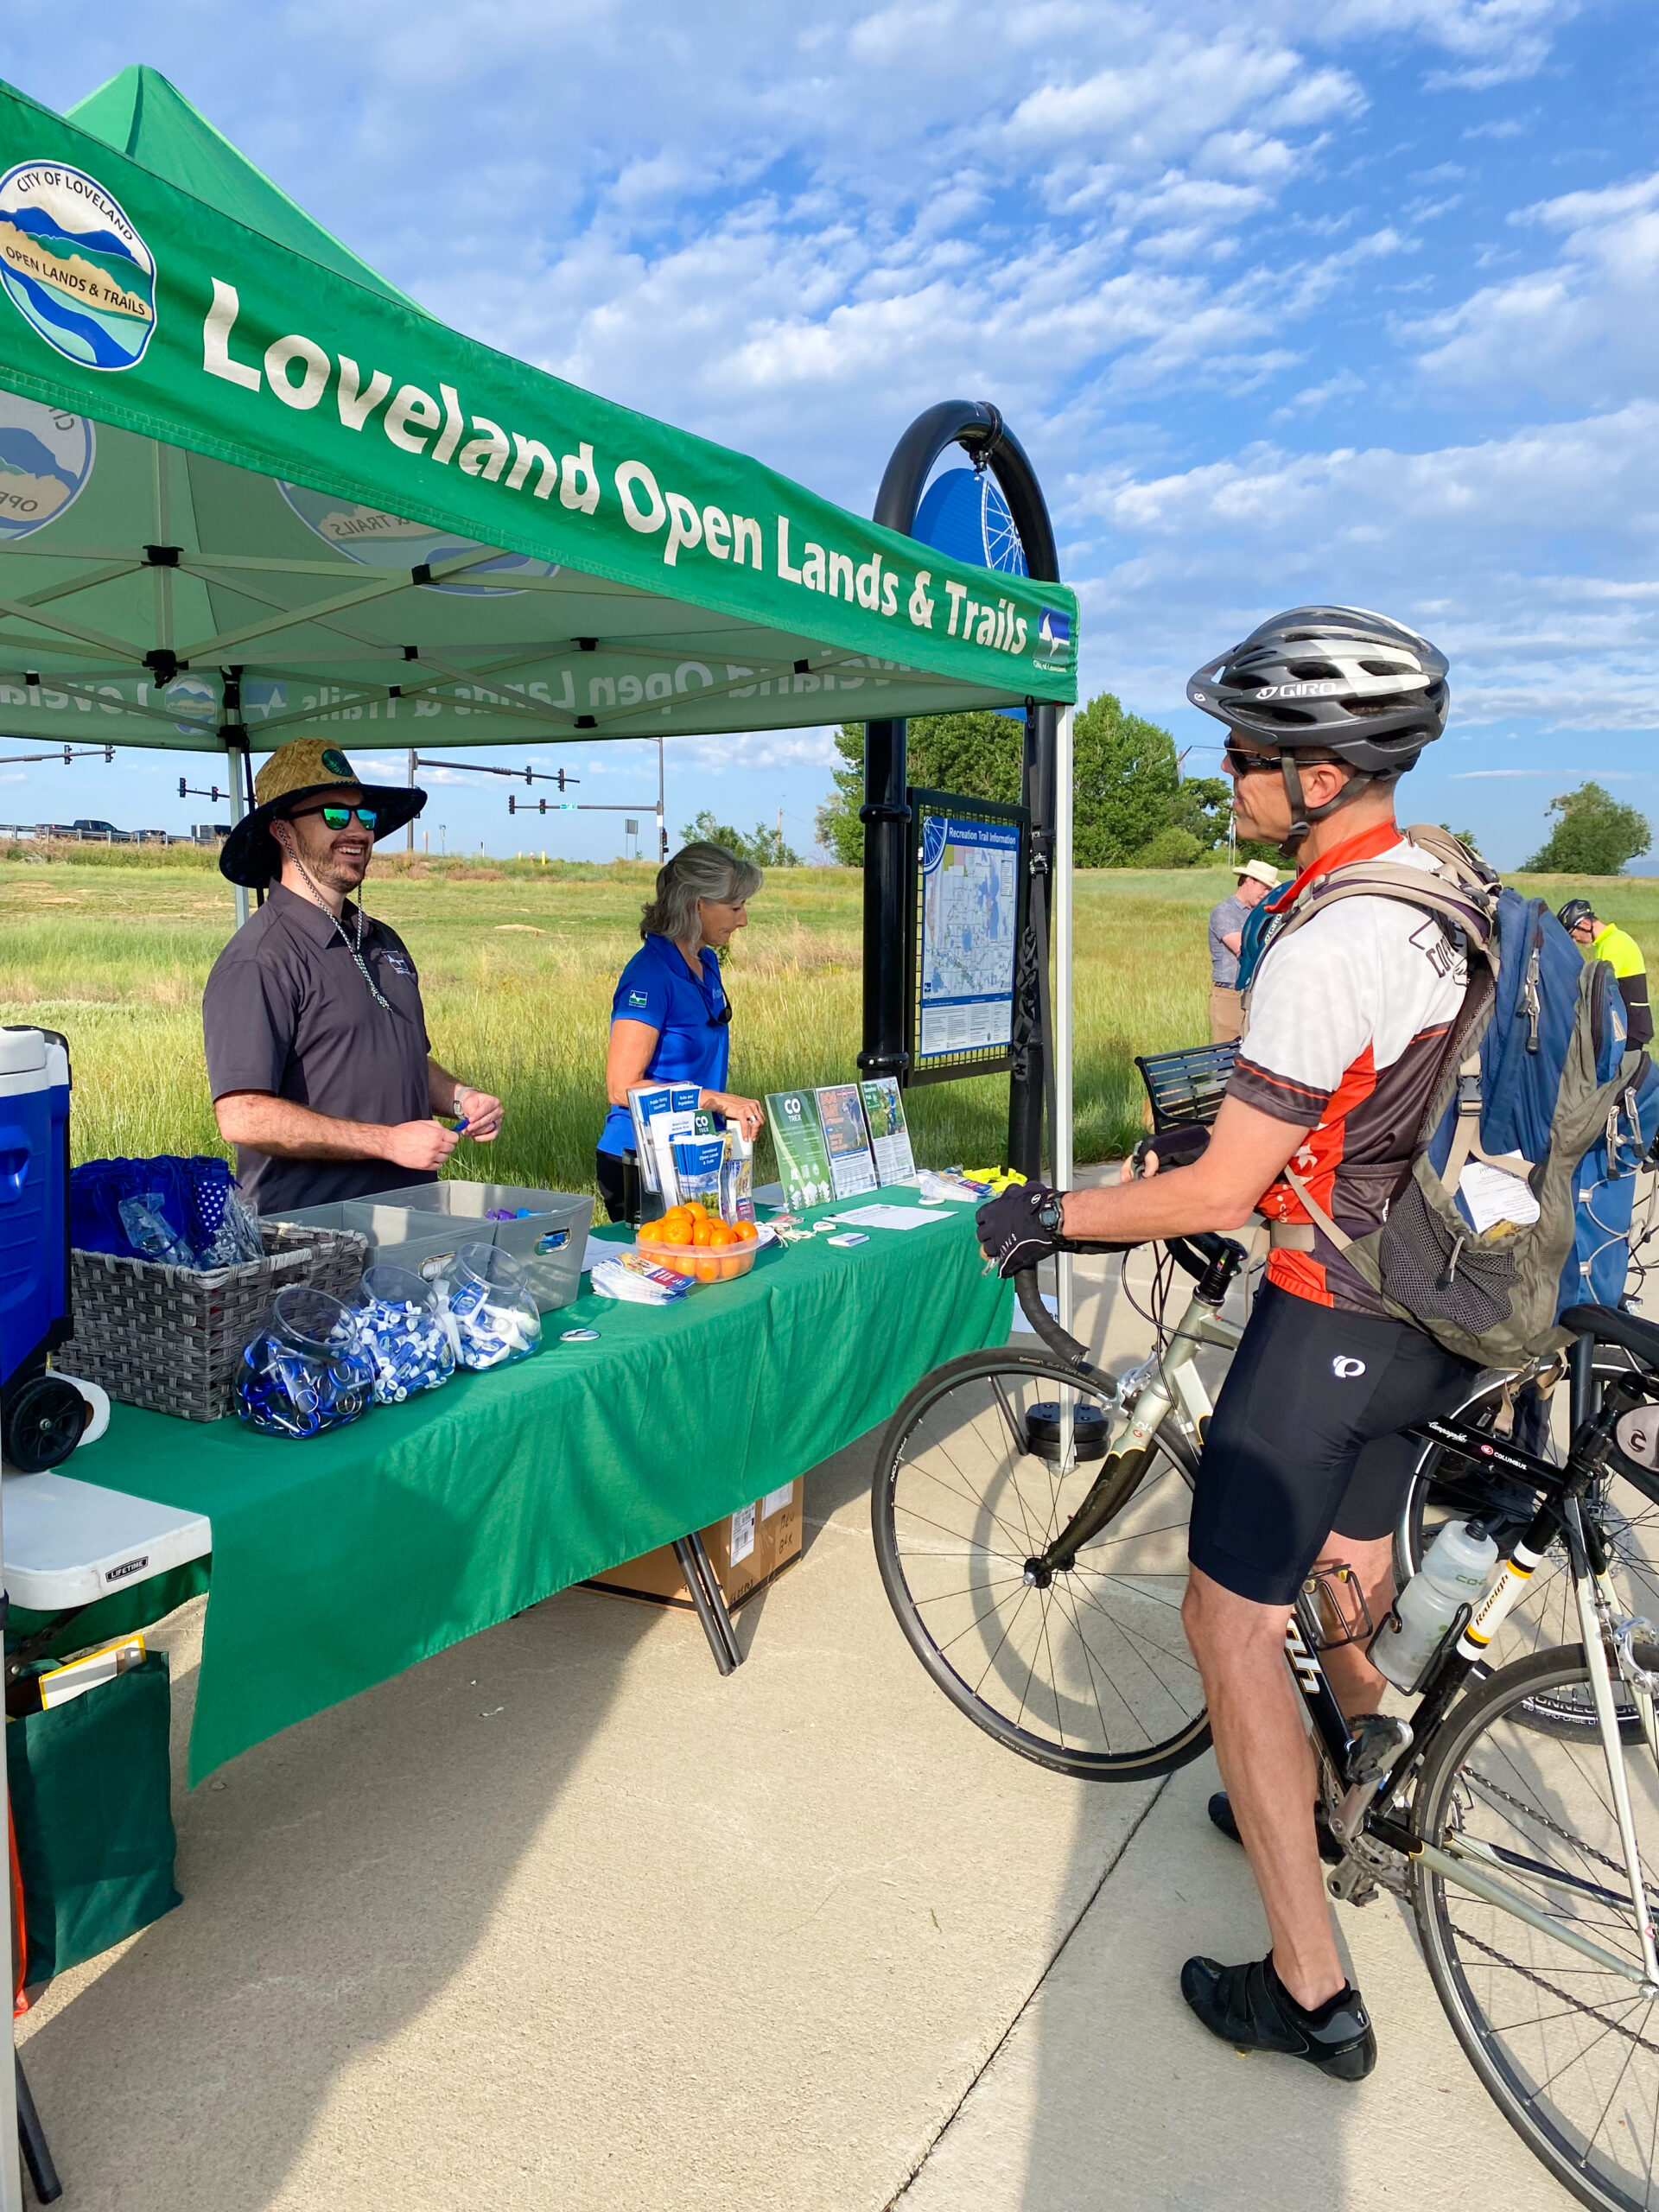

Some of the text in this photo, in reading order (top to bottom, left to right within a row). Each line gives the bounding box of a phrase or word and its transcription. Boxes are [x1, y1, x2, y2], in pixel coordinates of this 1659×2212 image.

[17, 172, 132, 241] CITY OF LOVELAND
[6, 246, 145, 315] OPEN LANDS & TRAILS
[203, 276, 1028, 654] Loveland Open Lands & Trails
[1280, 683, 1338, 697] GIRO
[949, 827, 1016, 845] Recreation Trail Information
[785, 1098, 801, 1115] CO
[695, 1116, 708, 1128] CO
[788, 1114, 802, 1122] TREX
[1494, 1452, 1528, 1471] COLUMBUS
[111, 1560, 144, 1579] LIFETIME
[1476, 1574, 1509, 1626] Raleigh
